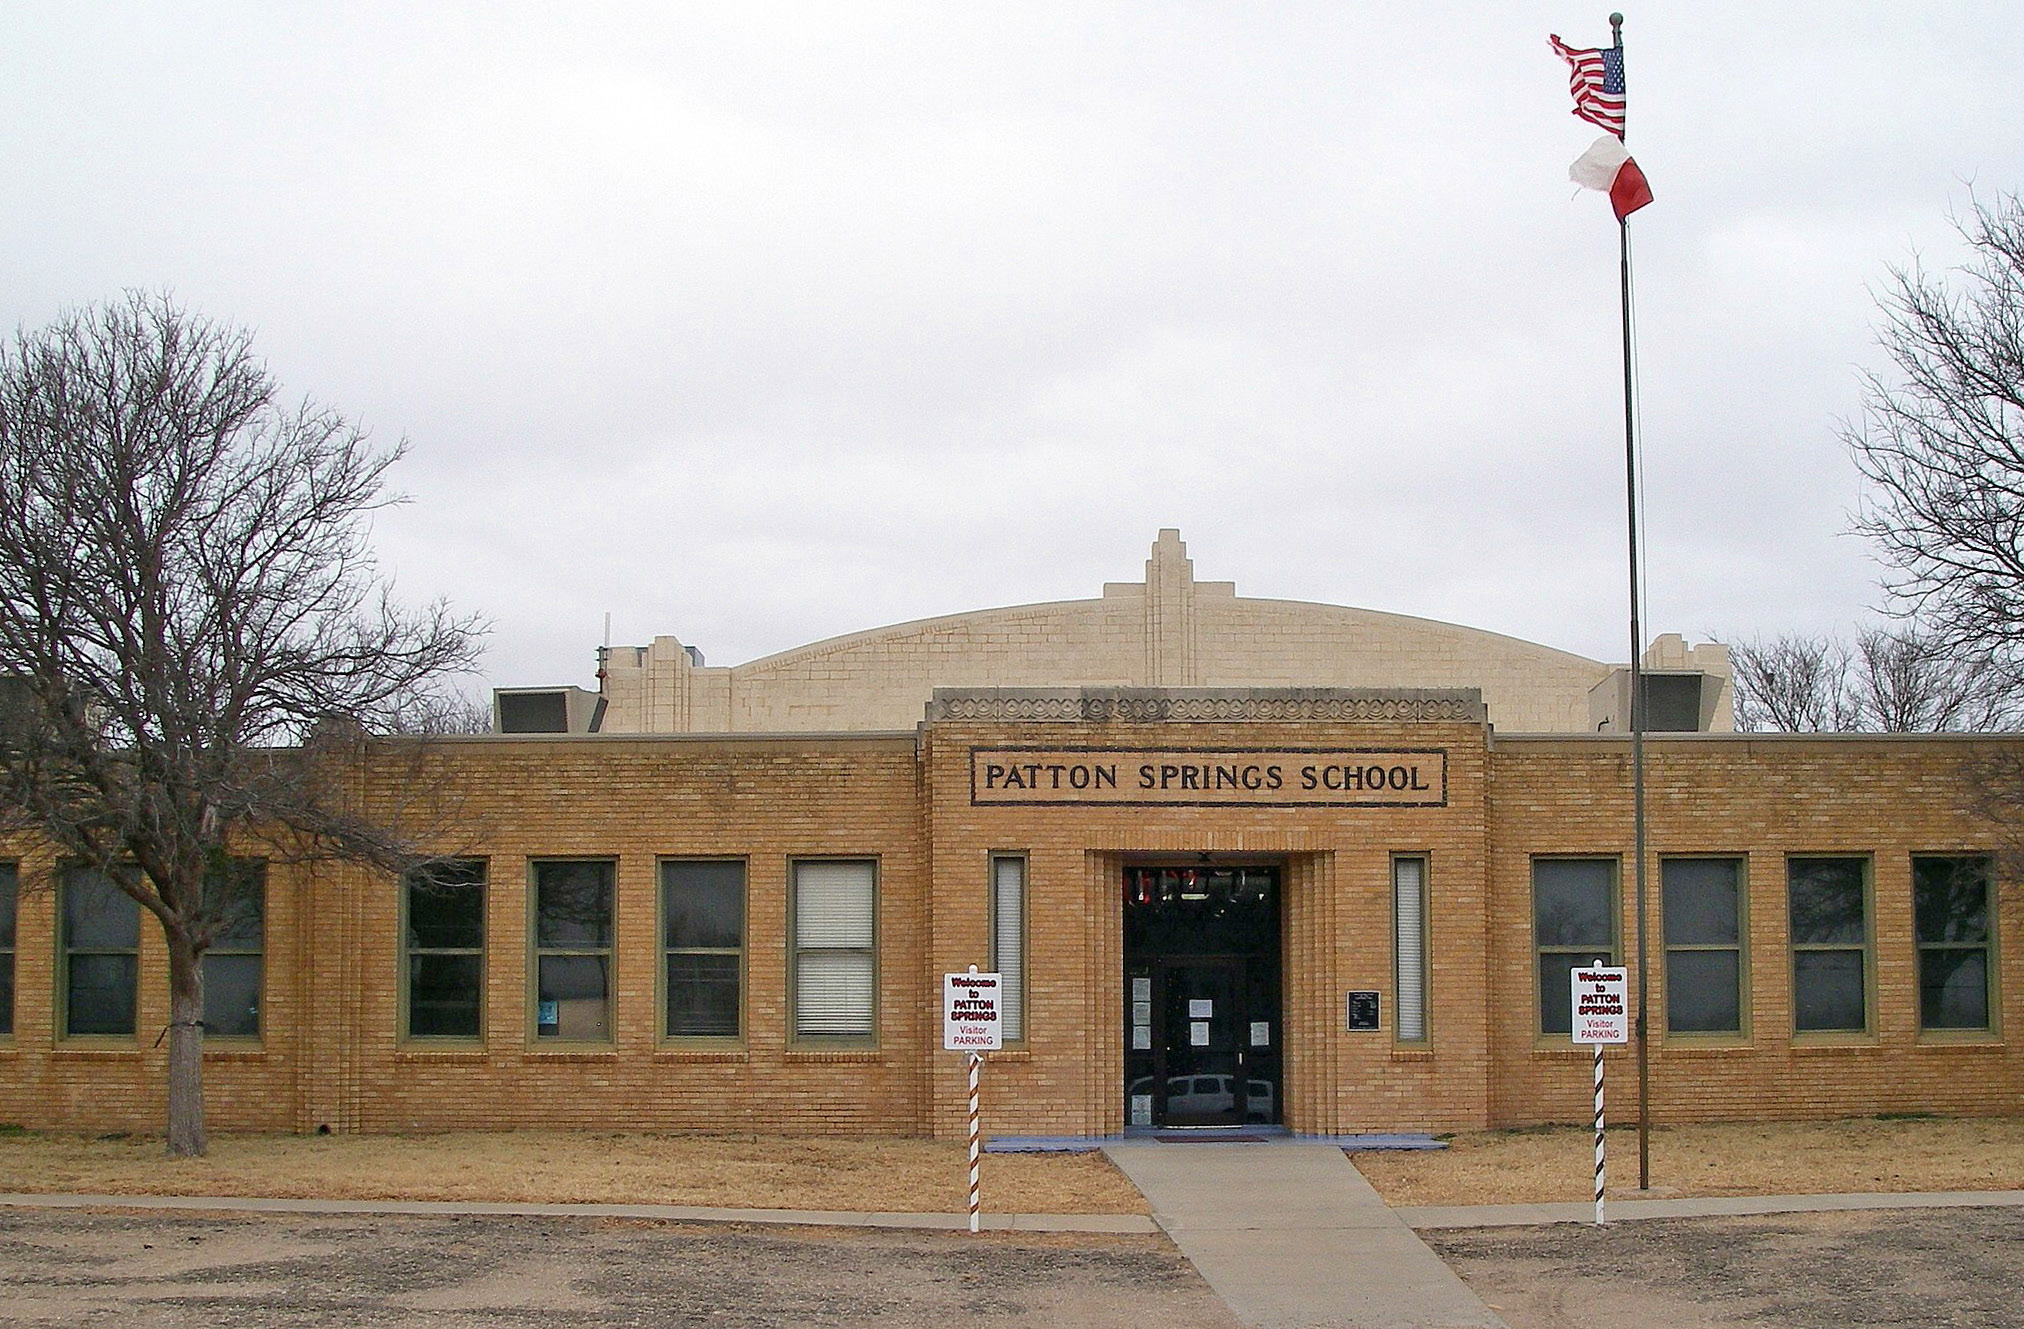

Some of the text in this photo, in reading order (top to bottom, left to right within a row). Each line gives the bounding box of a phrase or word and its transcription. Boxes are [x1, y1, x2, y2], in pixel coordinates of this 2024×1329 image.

[985, 764, 1430, 790] PATTON SPRINGS SCHOOL
[1578, 972, 1622, 982] Welcome
[952, 978, 996, 988] Welcome
[1595, 983, 1606, 992] to
[968, 989, 980, 998] to
[1581, 994, 1620, 1004] PATTON
[954, 1000, 994, 1010] PATTON
[1578, 1005, 1623, 1015] SPRINGS
[951, 1011, 997, 1021] SPRINGS
[1586, 1020, 1614, 1028] Visitor
[960, 1026, 988, 1034] Visitor
[1581, 1030, 1620, 1038] PARKING
[954, 1036, 994, 1044] PARKING
